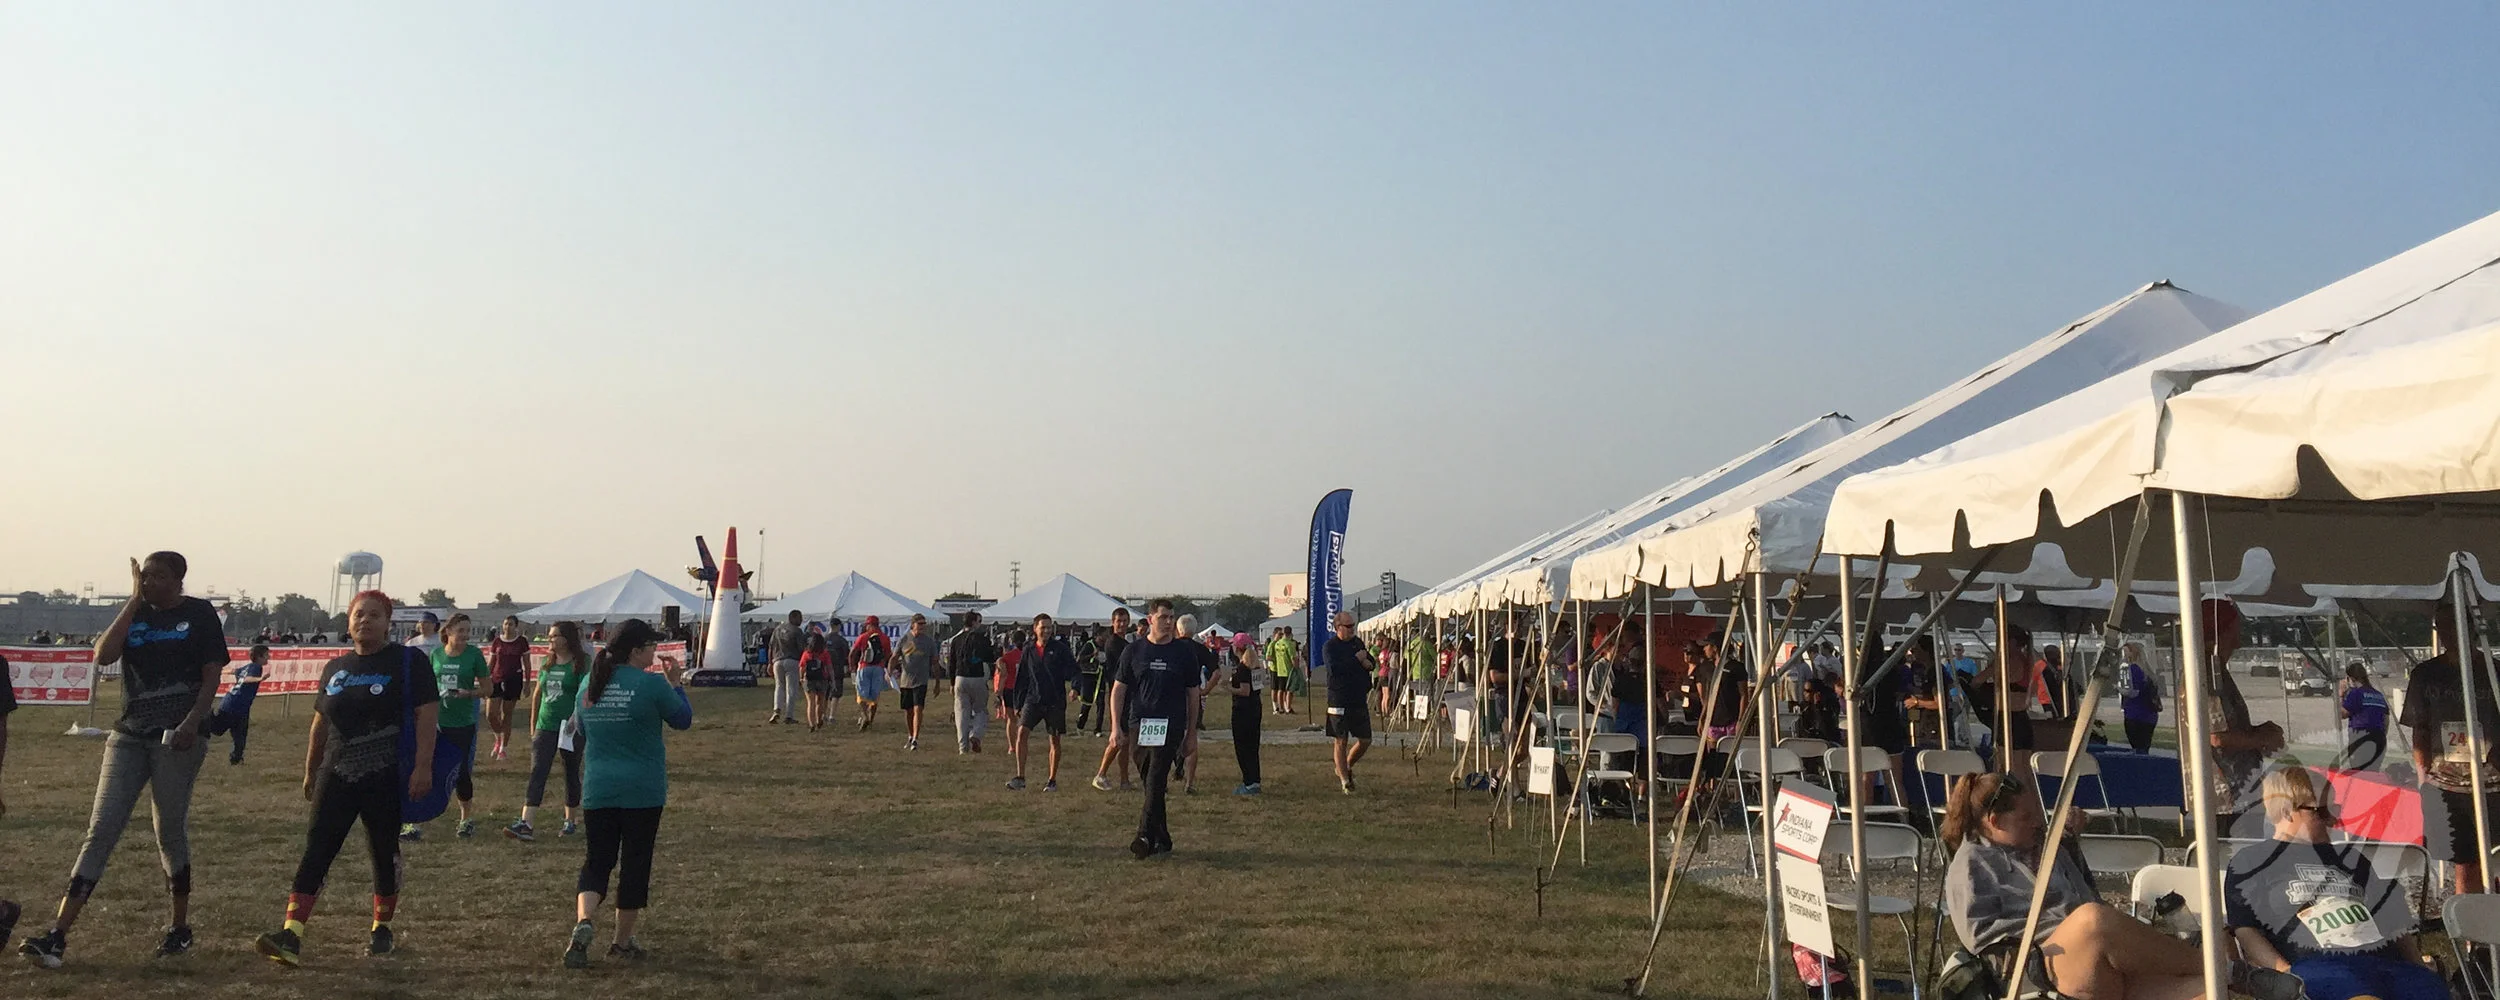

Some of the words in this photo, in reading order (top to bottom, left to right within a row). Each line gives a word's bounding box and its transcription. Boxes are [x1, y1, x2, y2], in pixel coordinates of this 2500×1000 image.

[1329, 535, 1340, 585] works
[1141, 724, 1166, 736] 2058
[1781, 822, 1803, 841] SPORTS
[1789, 813, 1813, 830] INDIANA
[1786, 885, 1801, 900] PACERS
[1800, 889, 1817, 905] SPORTS
[1789, 901, 1822, 922] ENTERTAINMENT
[2308, 904, 2370, 934] 2000
